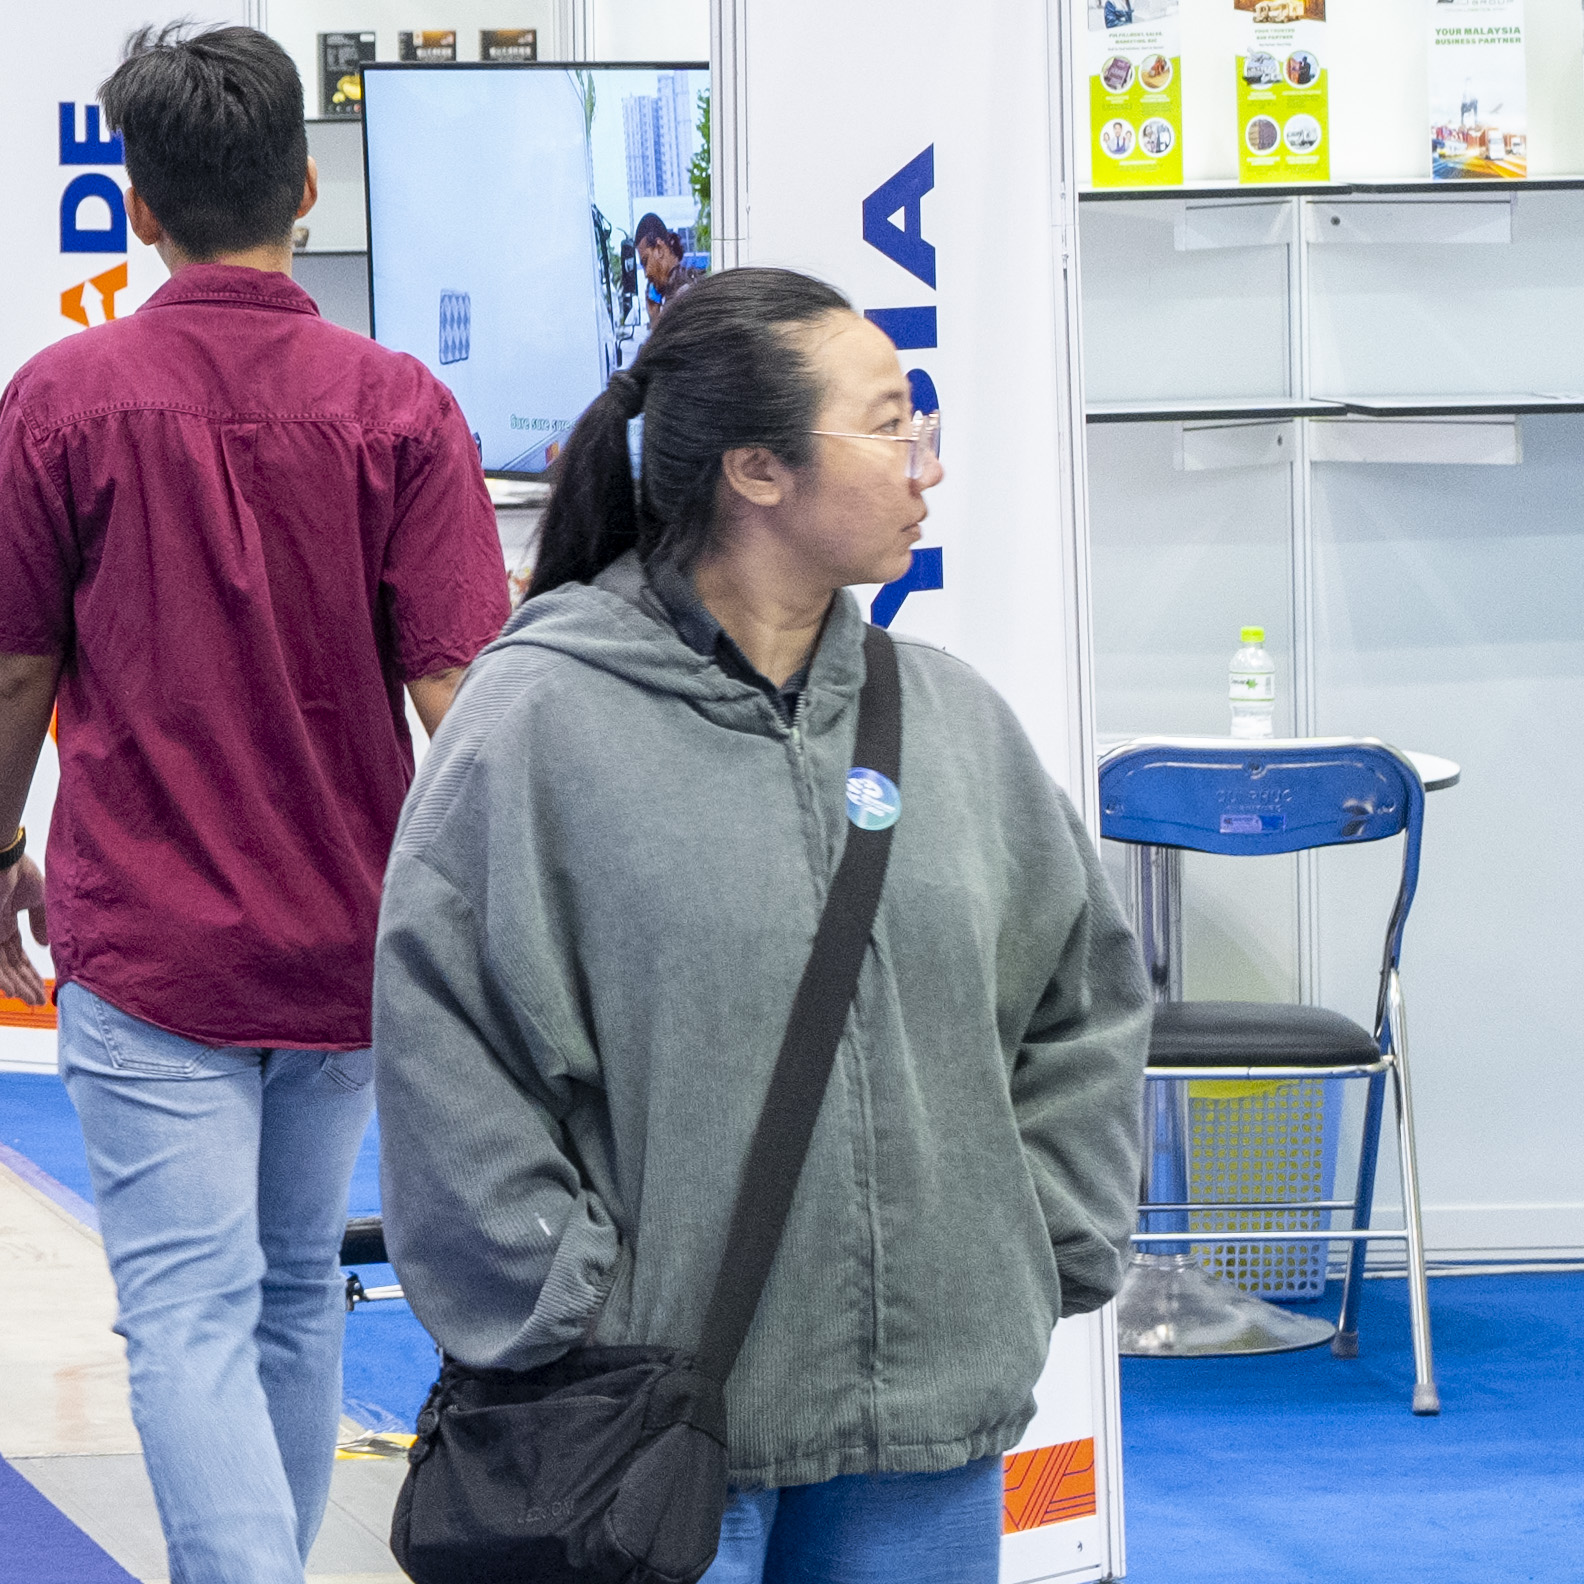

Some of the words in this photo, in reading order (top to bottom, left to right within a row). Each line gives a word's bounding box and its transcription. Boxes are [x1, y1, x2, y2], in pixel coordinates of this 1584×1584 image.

[1435, 27, 1462, 37] YOUR
[1464, 26, 1521, 35] MALAYSIA
[1435, 37, 1477, 46] BUSINESS
[1478, 36, 1522, 45] PARTNER
